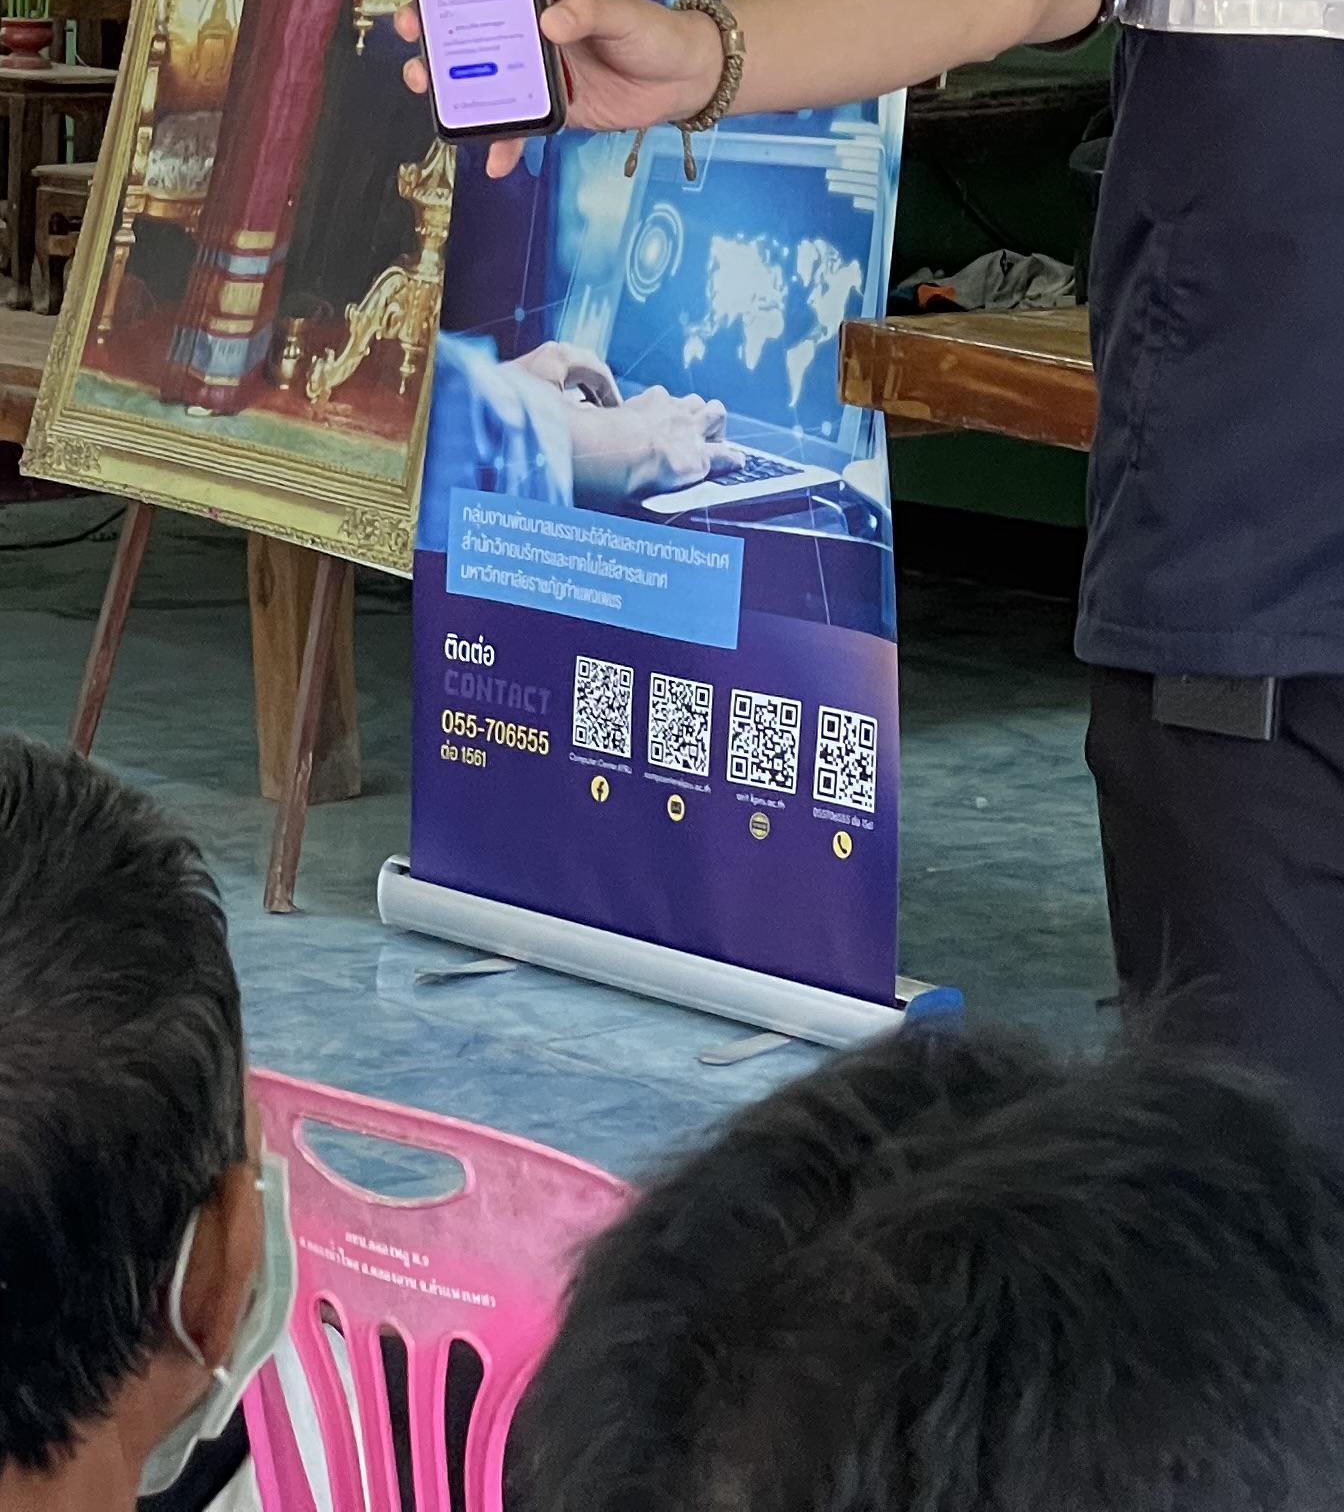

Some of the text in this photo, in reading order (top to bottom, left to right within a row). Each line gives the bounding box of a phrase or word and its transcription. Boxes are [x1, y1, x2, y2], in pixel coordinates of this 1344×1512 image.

[444, 632, 496, 667] ติดต่อ
[443, 668, 553, 716] CONTACT
[441, 709, 551, 755] 055-706555
[440, 740, 487, 768] ต่อ 1561
